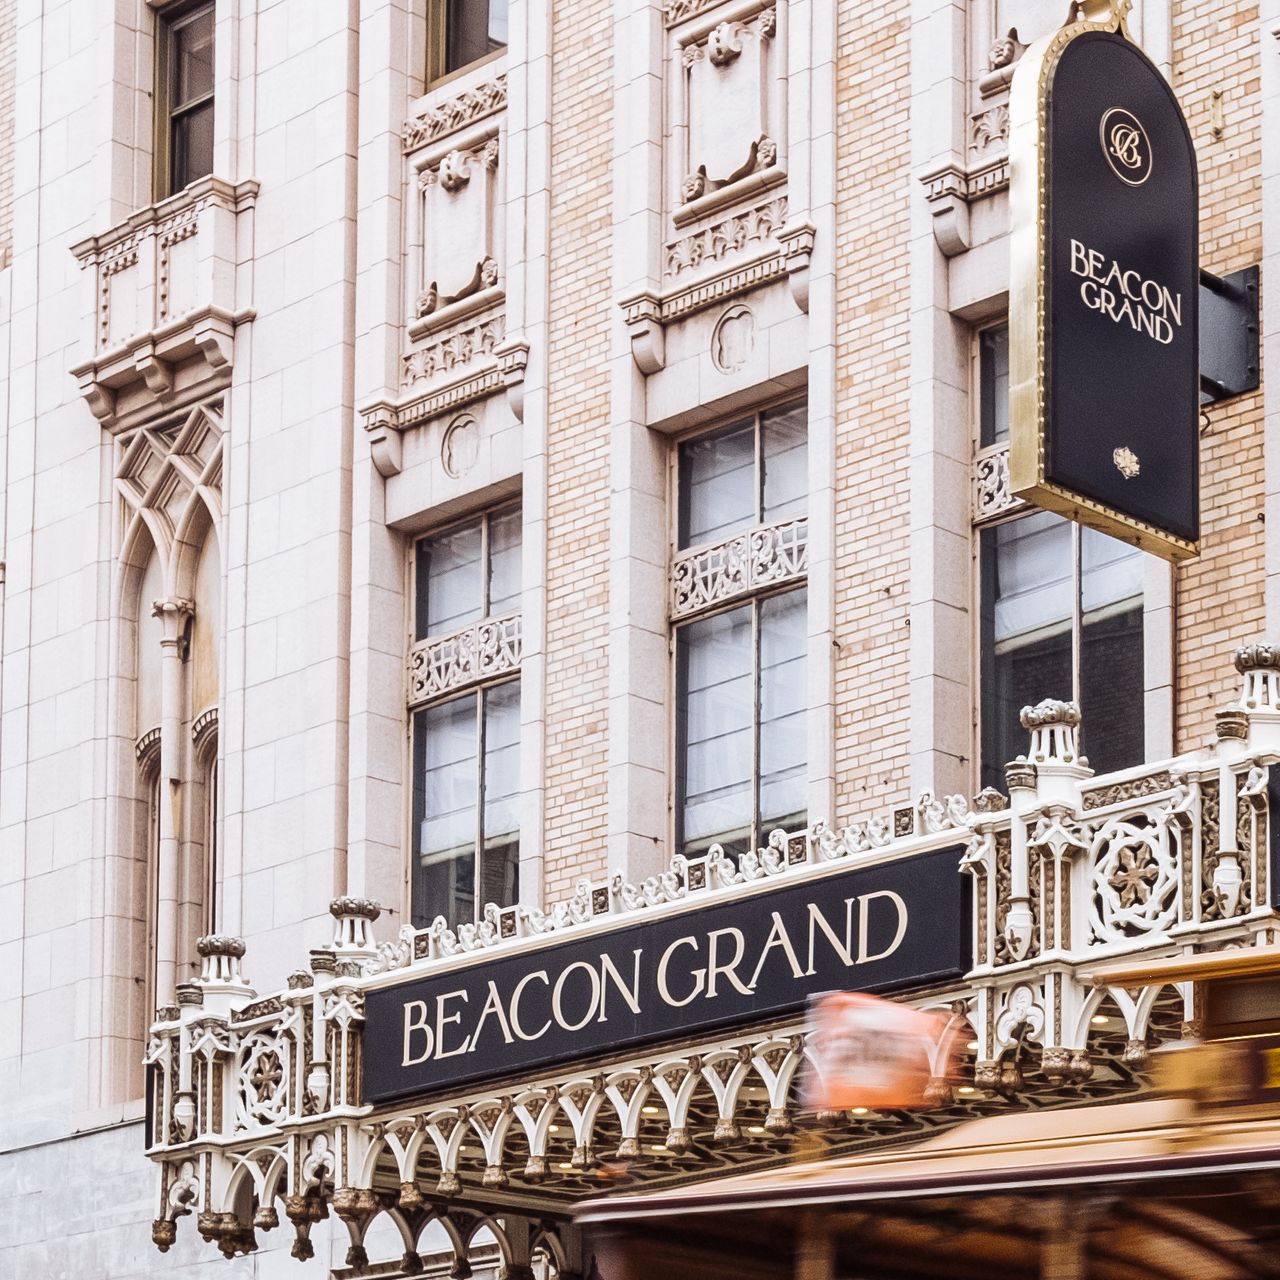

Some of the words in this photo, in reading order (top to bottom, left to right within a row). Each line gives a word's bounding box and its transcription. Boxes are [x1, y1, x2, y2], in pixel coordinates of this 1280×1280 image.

[1069, 237, 1183, 328] BEACON
[1079, 281, 1175, 347] GRAND
[400, 947, 643, 1068] BEACON
[656, 888, 909, 1008] GRAND
